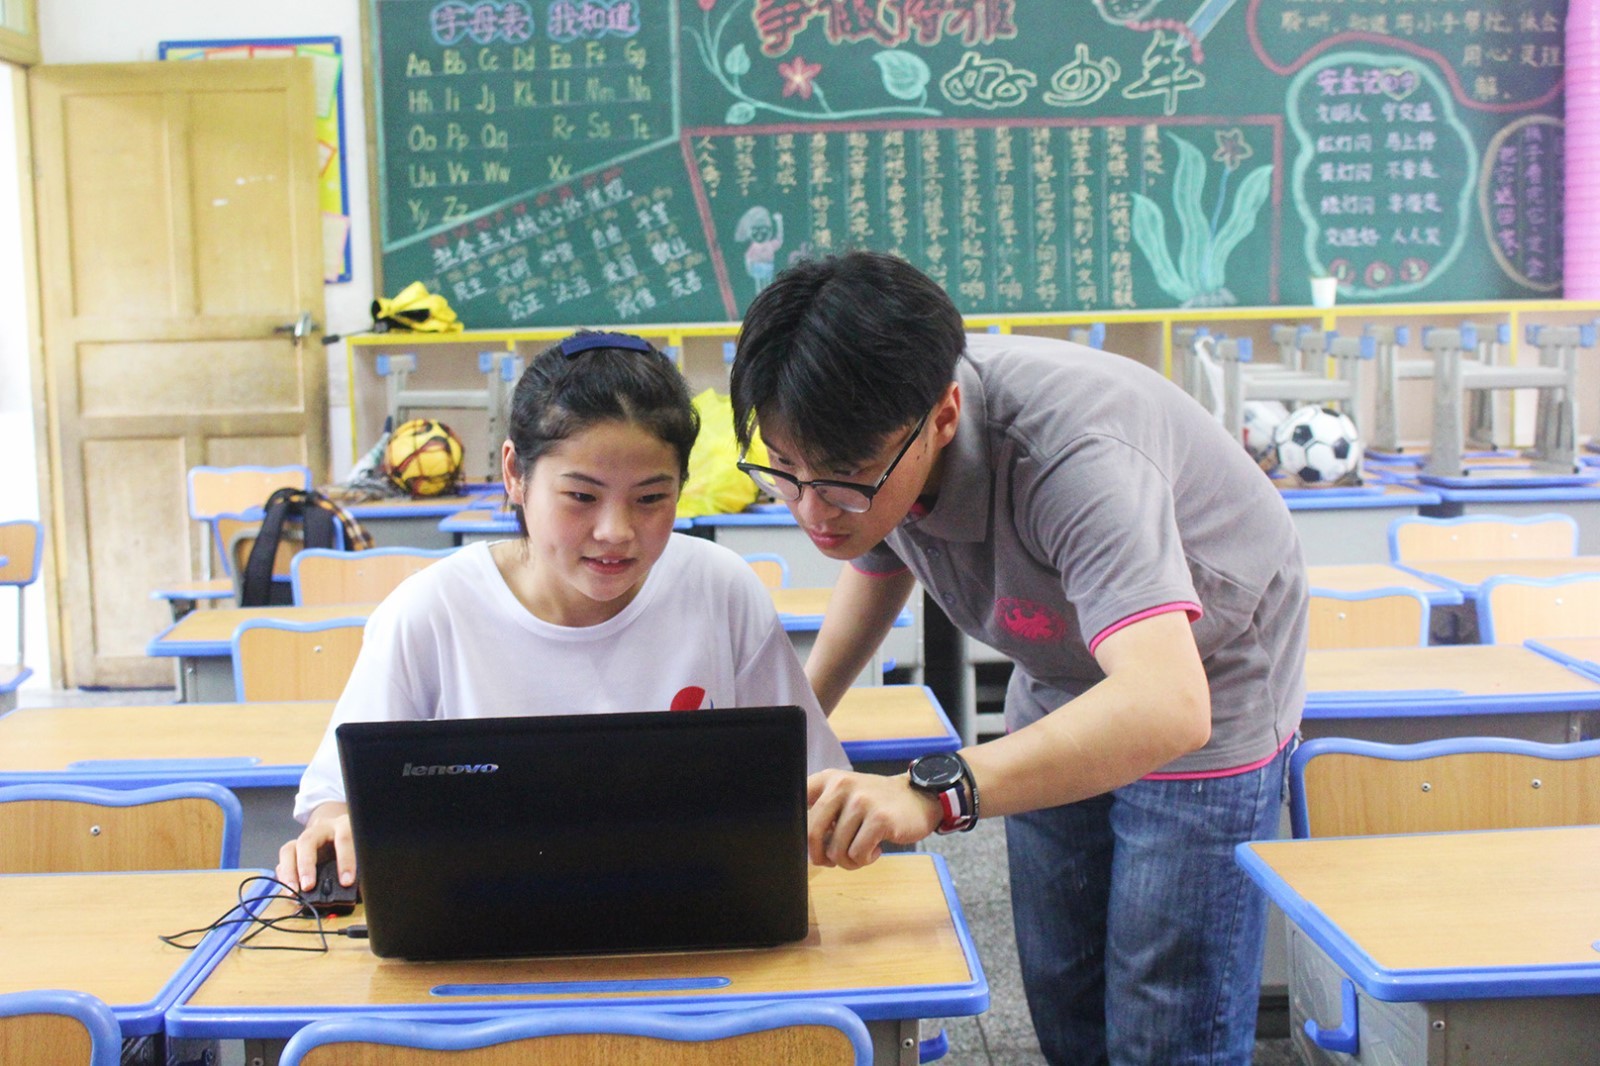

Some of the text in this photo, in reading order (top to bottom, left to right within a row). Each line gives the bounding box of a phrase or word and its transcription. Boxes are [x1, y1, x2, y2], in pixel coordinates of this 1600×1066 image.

[432, 1, 640, 42] 字母表 我知道
[407, 40, 646, 77] Aa Bb Cc Dd Ee Ff Gg
[409, 88, 433, 113] Hh
[445, 87, 459, 111] Ii
[476, 85, 496, 113] Jj
[513, 81, 536, 107] Kk
[551, 80, 570, 105] Ll
[408, 125, 437, 151] Oo
[447, 123, 468, 150] Pp
[553, 115, 575, 140] Rr
[588, 111, 611, 138] Ss
[629, 113, 650, 140] Tt
[409, 163, 437, 188] Uu
[449, 162, 469, 183] Vv
[483, 161, 511, 183] Ww
[548, 155, 573, 180] Xx
[408, 199, 430, 230] Yy
[441, 195, 468, 224] Zz
[402, 763, 499, 777] lenovo
